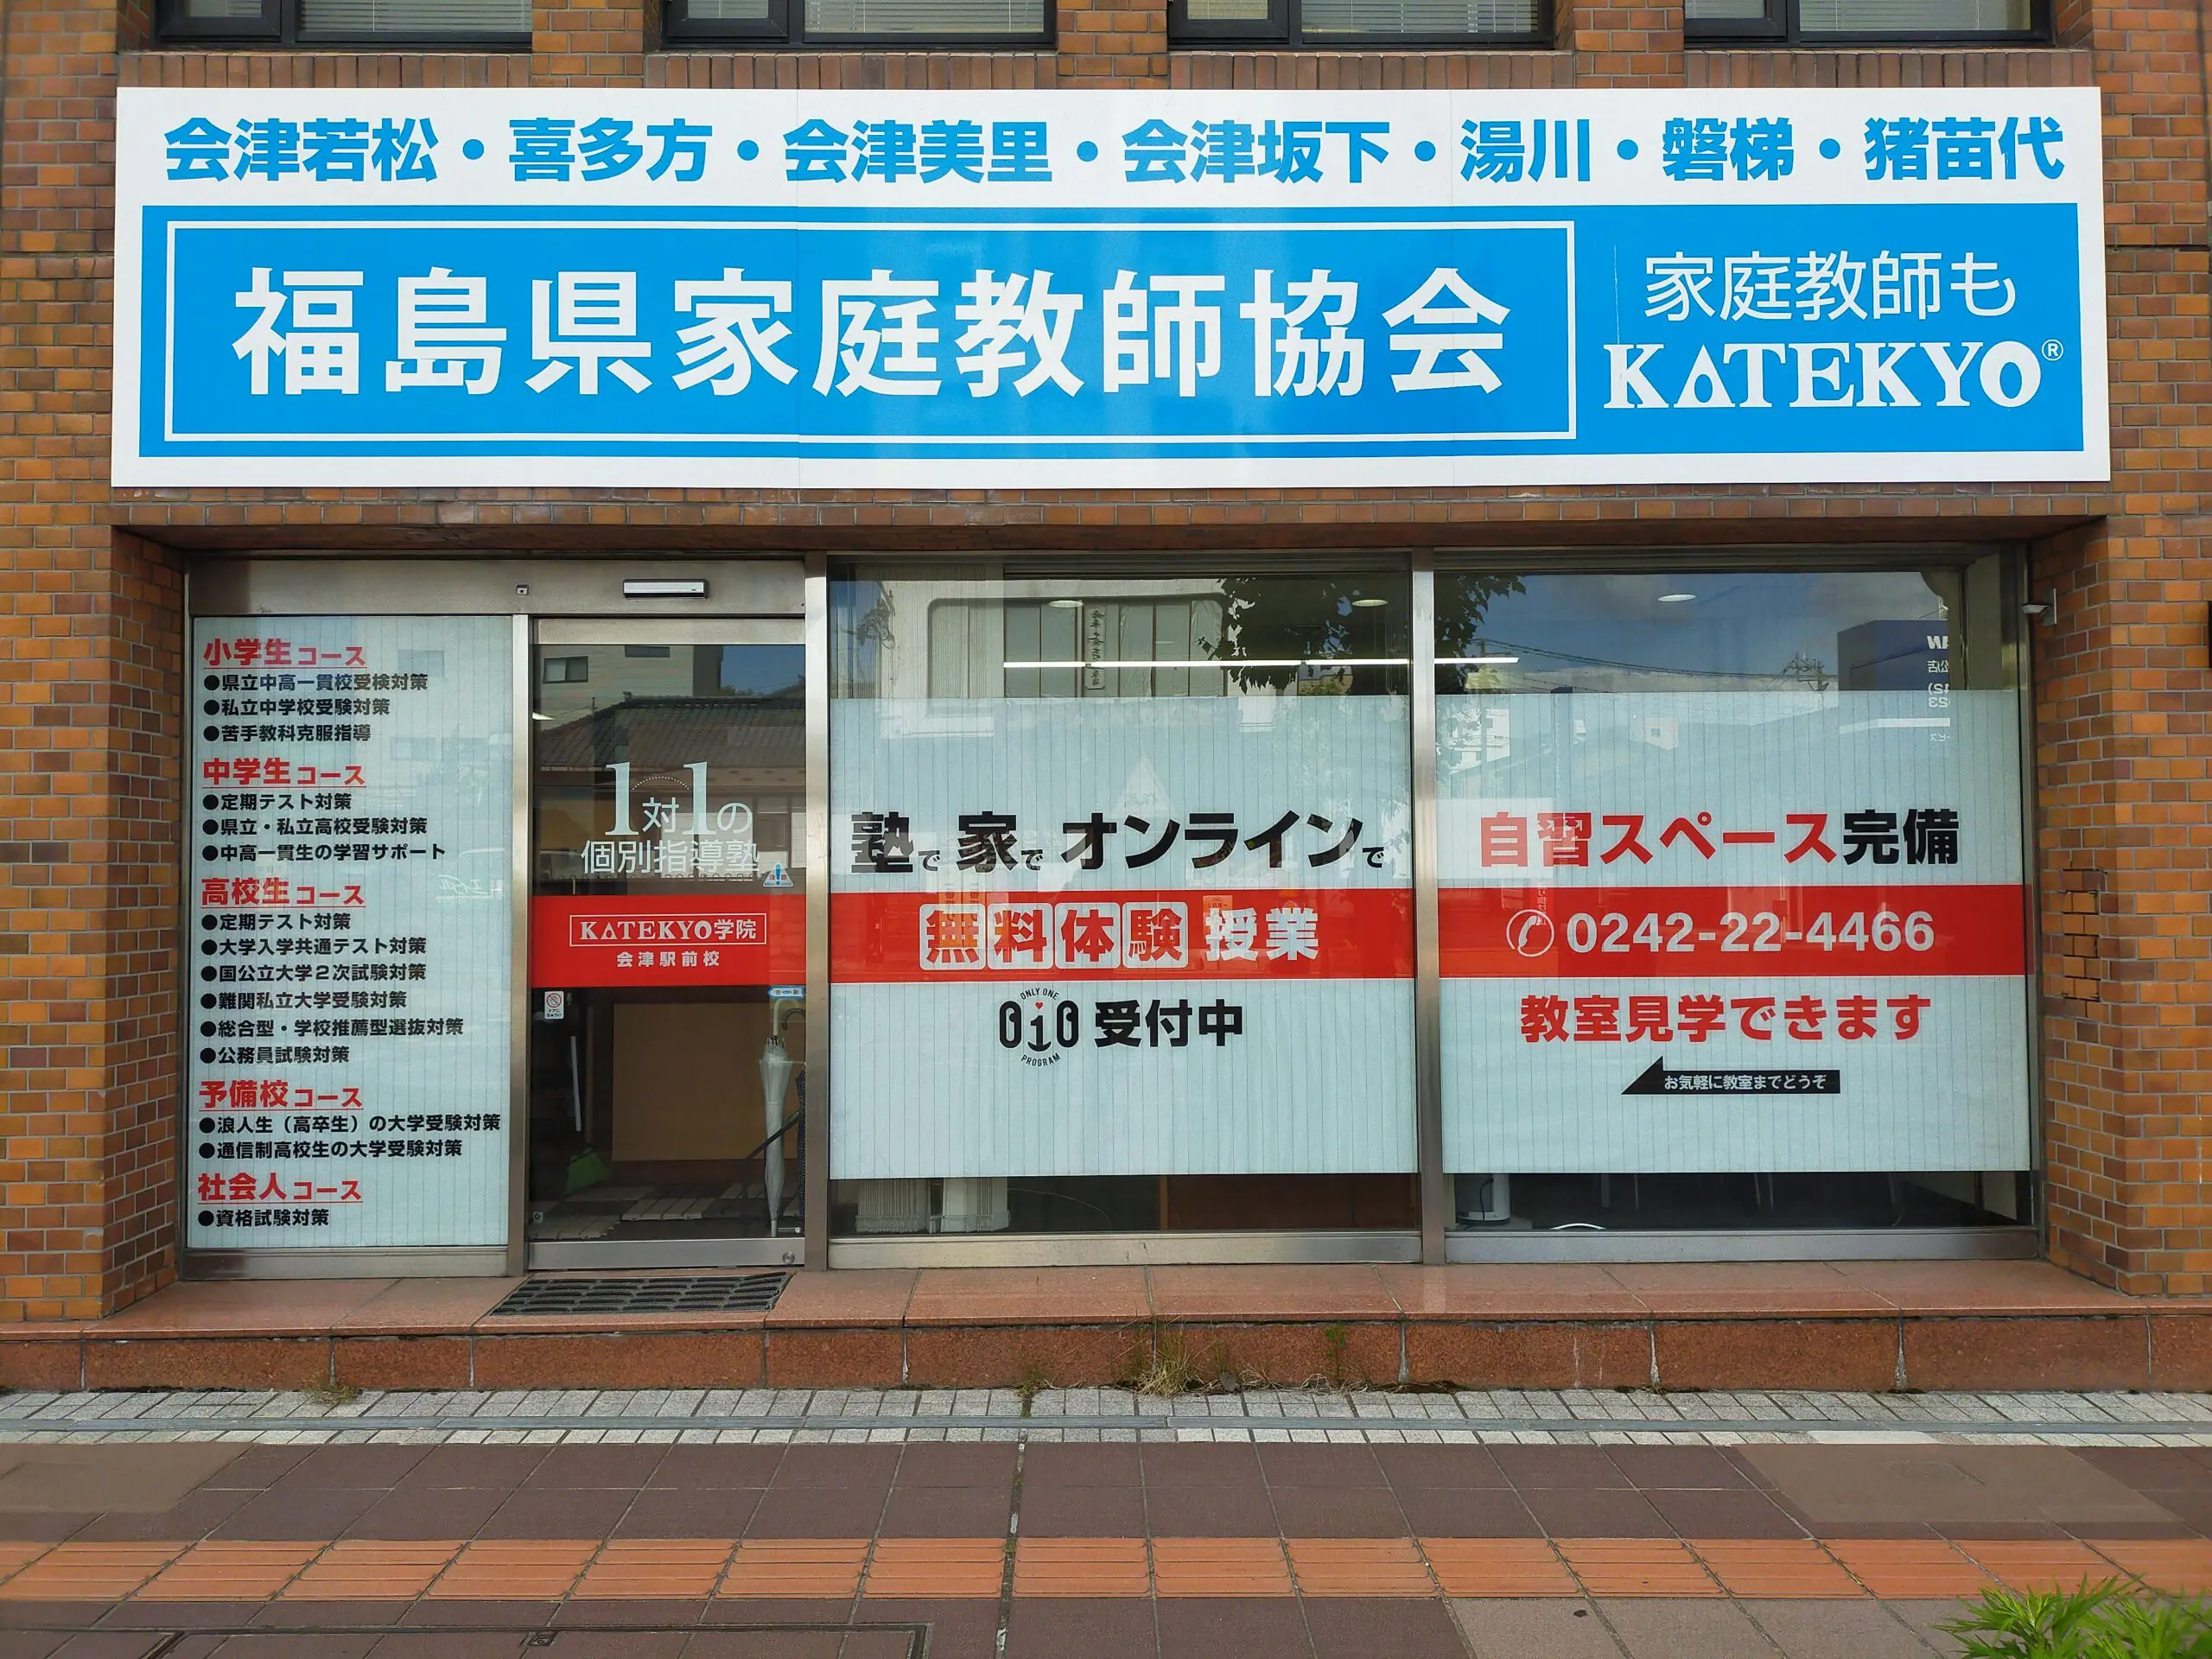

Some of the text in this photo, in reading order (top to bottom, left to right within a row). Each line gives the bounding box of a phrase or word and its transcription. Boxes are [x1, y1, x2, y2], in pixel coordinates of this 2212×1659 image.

[1646, 251, 2015, 321] 家庭教師も
[232, 267, 1510, 397] 福島県家庭教師協会
[205, 637, 364, 666] 小学生コース
[222, 673, 428, 691] 県立中高一貫校受検対策
[221, 698, 390, 716] 私立中学校受験対策
[221, 724, 370, 741] 苦手教科克服指導
[203, 757, 365, 785] 中学生コース
[221, 793, 351, 810] 定期テスト対策
[221, 817, 427, 836] 県立・私立高校受験対策
[1479, 809, 1960, 868] 自習スペース完備
[221, 843, 445, 861] 中高一貫生の学習サポート
[581, 840, 760, 874] 個別指導塾
[201, 876, 364, 905] 高校生コース
[220, 913, 350, 931] 定期テスト対策
[581, 918, 757, 941] KATEKYO学院
[1567, 908, 1934, 952] 0242-22-4466
[925, 906, 1320, 963] 無料体験授業
[219, 938, 426, 956] 大学入学共通テスト対策
[616, 951, 721, 968] 会津駅前校
[219, 991, 406, 1009] 難関私立大学受験対策
[1020, 988, 1059, 1000] ONLY ONE
[219, 1018, 463, 1038] 総合型・学校推薦型選抜対策
[1095, 999, 1243, 1047] 受付中
[1521, 995, 1931, 1043] 教室見学できます
[219, 1046, 349, 1064] 公務員試験対策
[1020, 1052, 1061, 1067] PROGRAM
[1665, 1075, 1825, 1090] お気軽に教室までどうぞ
[200, 1079, 361, 1108] 予備校コース
[218, 1140, 461, 1159] 通信制高校生の大学受験対策
[197, 1172, 360, 1201] 社会人コース
[216, 1209, 328, 1227] 資格試験対策
